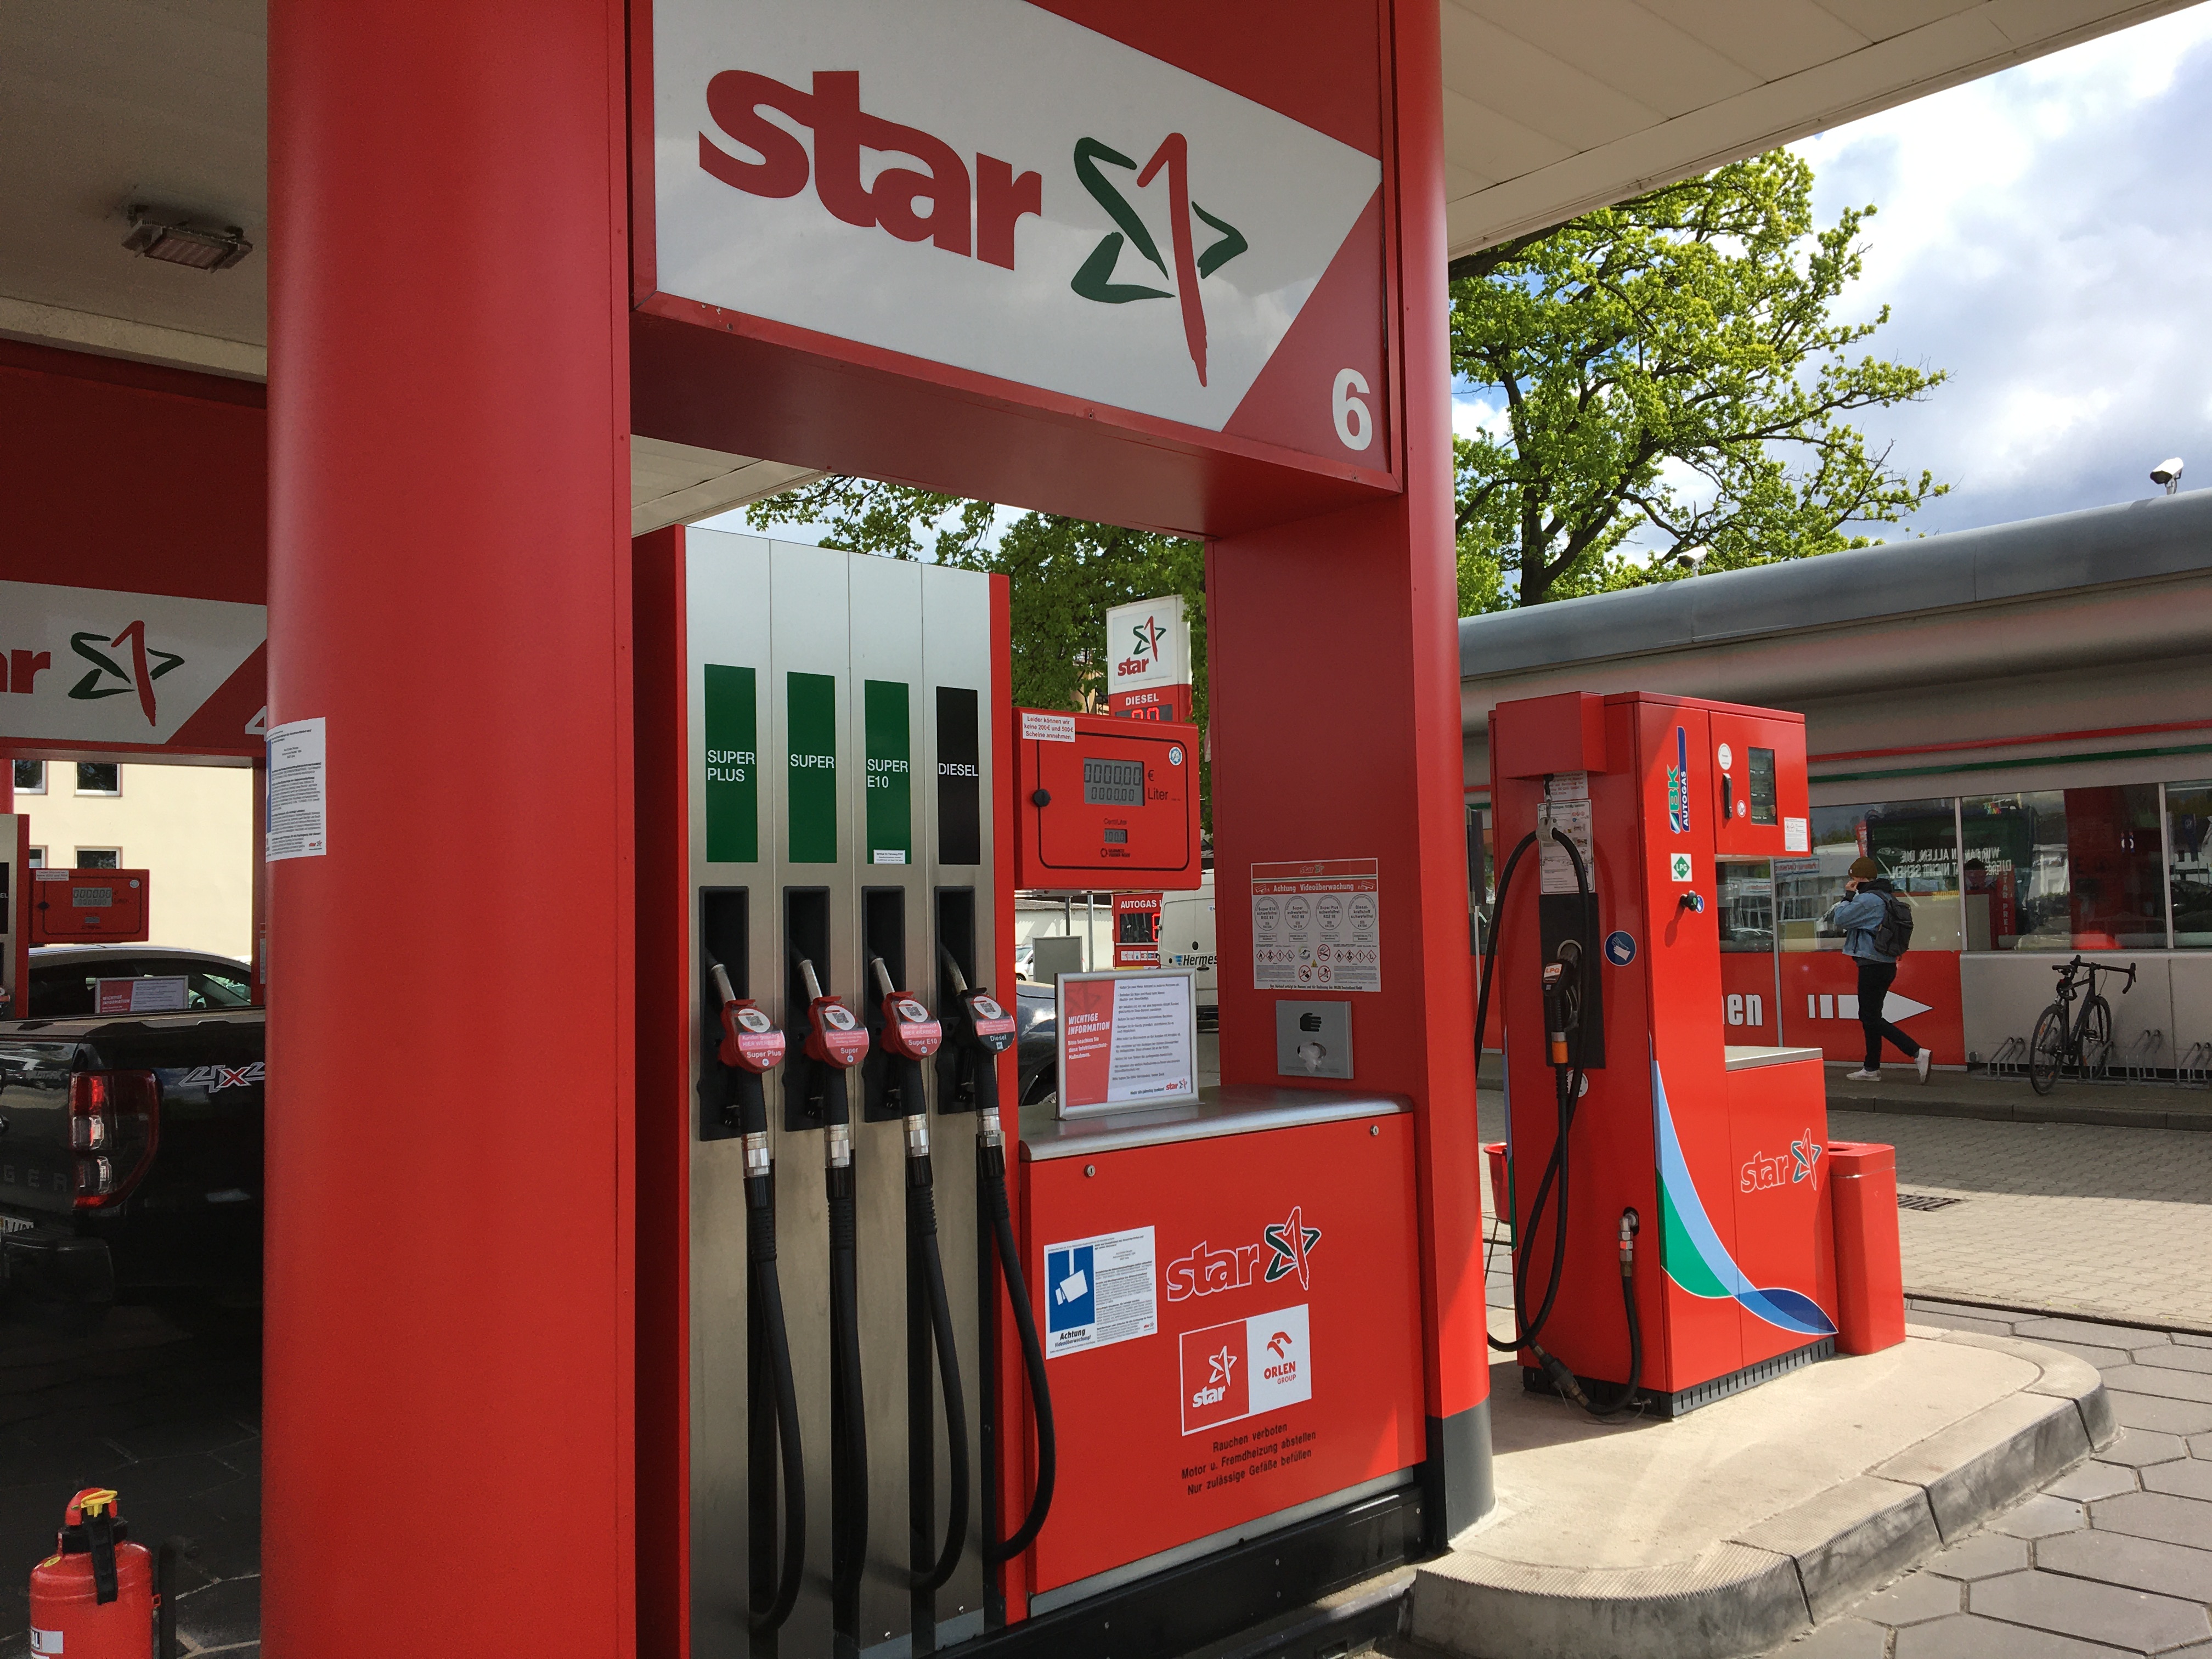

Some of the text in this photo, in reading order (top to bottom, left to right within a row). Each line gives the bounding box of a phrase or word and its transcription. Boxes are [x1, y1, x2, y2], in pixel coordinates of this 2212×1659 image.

[698, 70, 1042, 271] star
[1330, 366, 1374, 452] 6
[0, 650, 51, 693] r
[1118, 657, 1149, 676] star
[1125, 693, 1159, 706] DIESEL
[245, 706, 267, 741] 4
[707, 750, 755, 765] SUPER
[790, 754, 834, 769] SUPER
[867, 759, 909, 773] SUPER
[938, 763, 979, 777] DIESEL
[707, 768, 745, 782] PLUS
[867, 775, 889, 788] E10
[1148, 770, 1154, 781] €
[1148, 788, 1169, 800] Liter
[1680, 771, 1689, 827] AUTOGAS
[1300, 882, 1354, 891] Videoüberwachung
[1120, 899, 1156, 909] AUTOGAS
[1183, 955, 1217, 966] Hermes
[1722, 994, 1763, 1026] en
[1068, 1013, 1098, 1025] WICHTIGE
[1068, 1021, 1110, 1035] INFORMATION
[1166, 1082, 1178, 1091] star
[1741, 1150, 1788, 1193] star
[1166, 1240, 1260, 1302] star
[1059, 1329, 1086, 1341] Achtung
[1264, 1361, 1296, 1380] ORLEN
[1277, 1374, 1296, 1385] GROUP
[1192, 1385, 1226, 1408] star
[1213, 1423, 1288, 1453] Rauchen verboten
[1182, 1431, 1316, 1479] Motor u. Fremdheizung abstellen
[1188, 1449, 1312, 1496] Nur zulässige Gefäße befüllen
